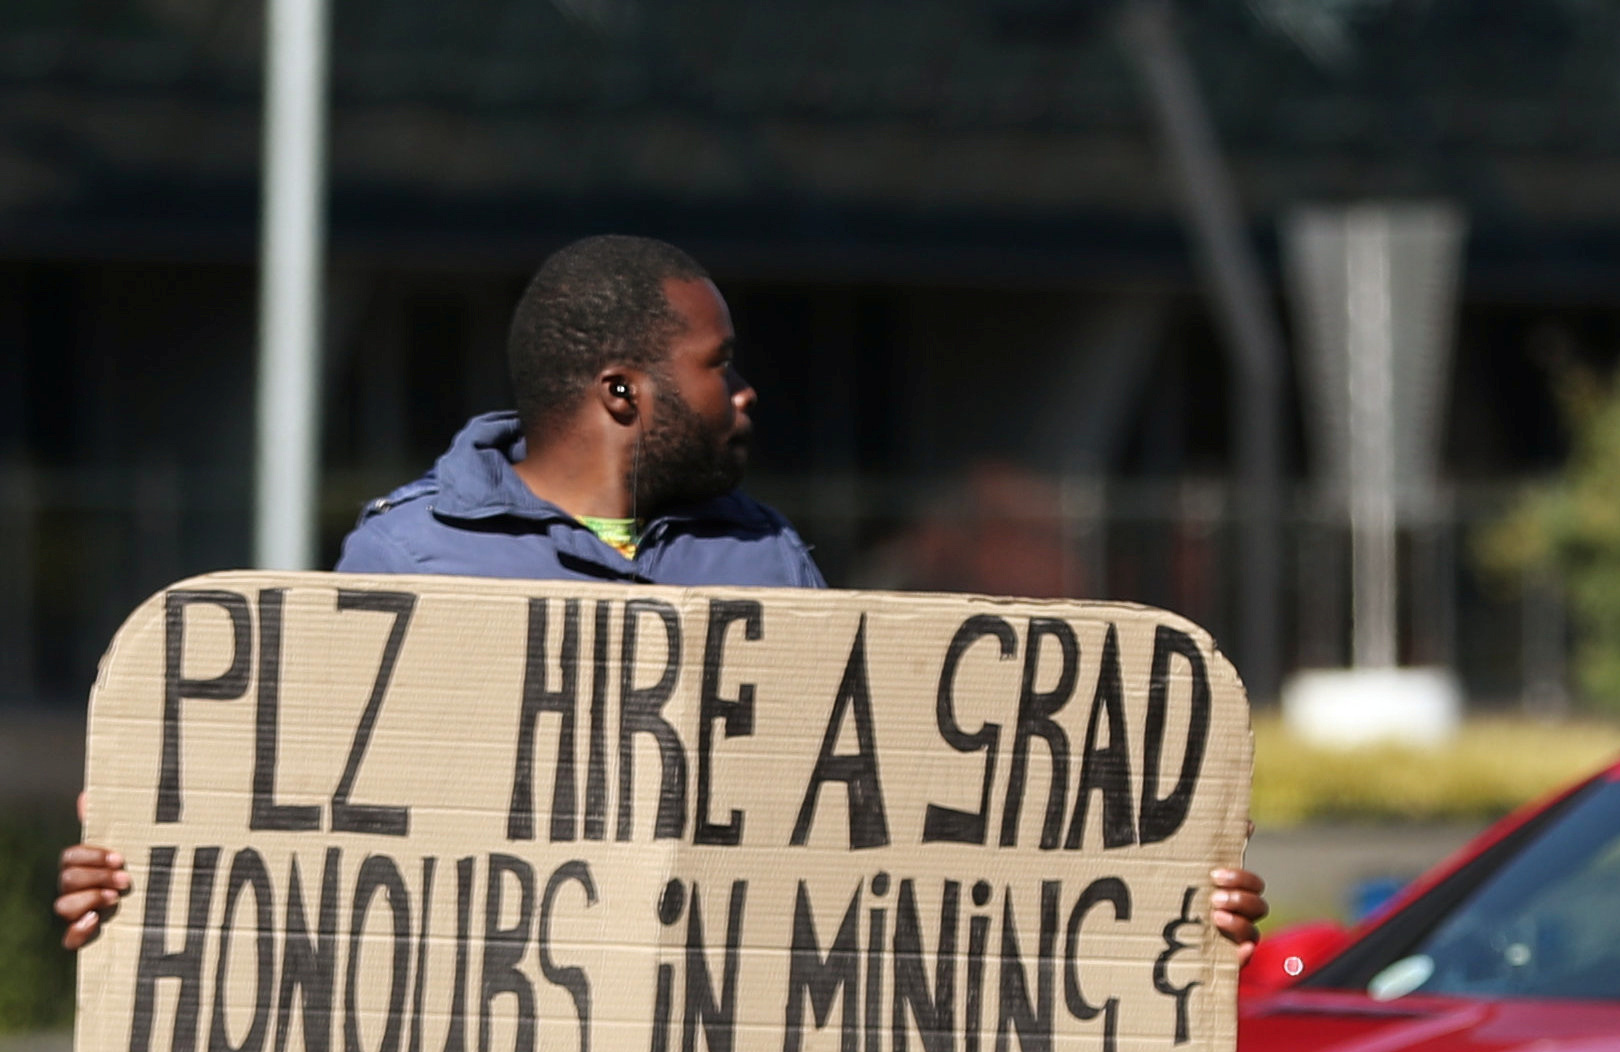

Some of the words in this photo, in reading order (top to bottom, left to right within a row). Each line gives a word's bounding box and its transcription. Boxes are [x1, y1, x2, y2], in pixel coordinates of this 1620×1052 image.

[155, 588, 417, 837] PLZ
[507, 597, 763, 845] HIRE
[789, 611, 890, 850] A
[922, 613, 1212, 850] GRAD
[1152, 886, 1203, 1045] &
